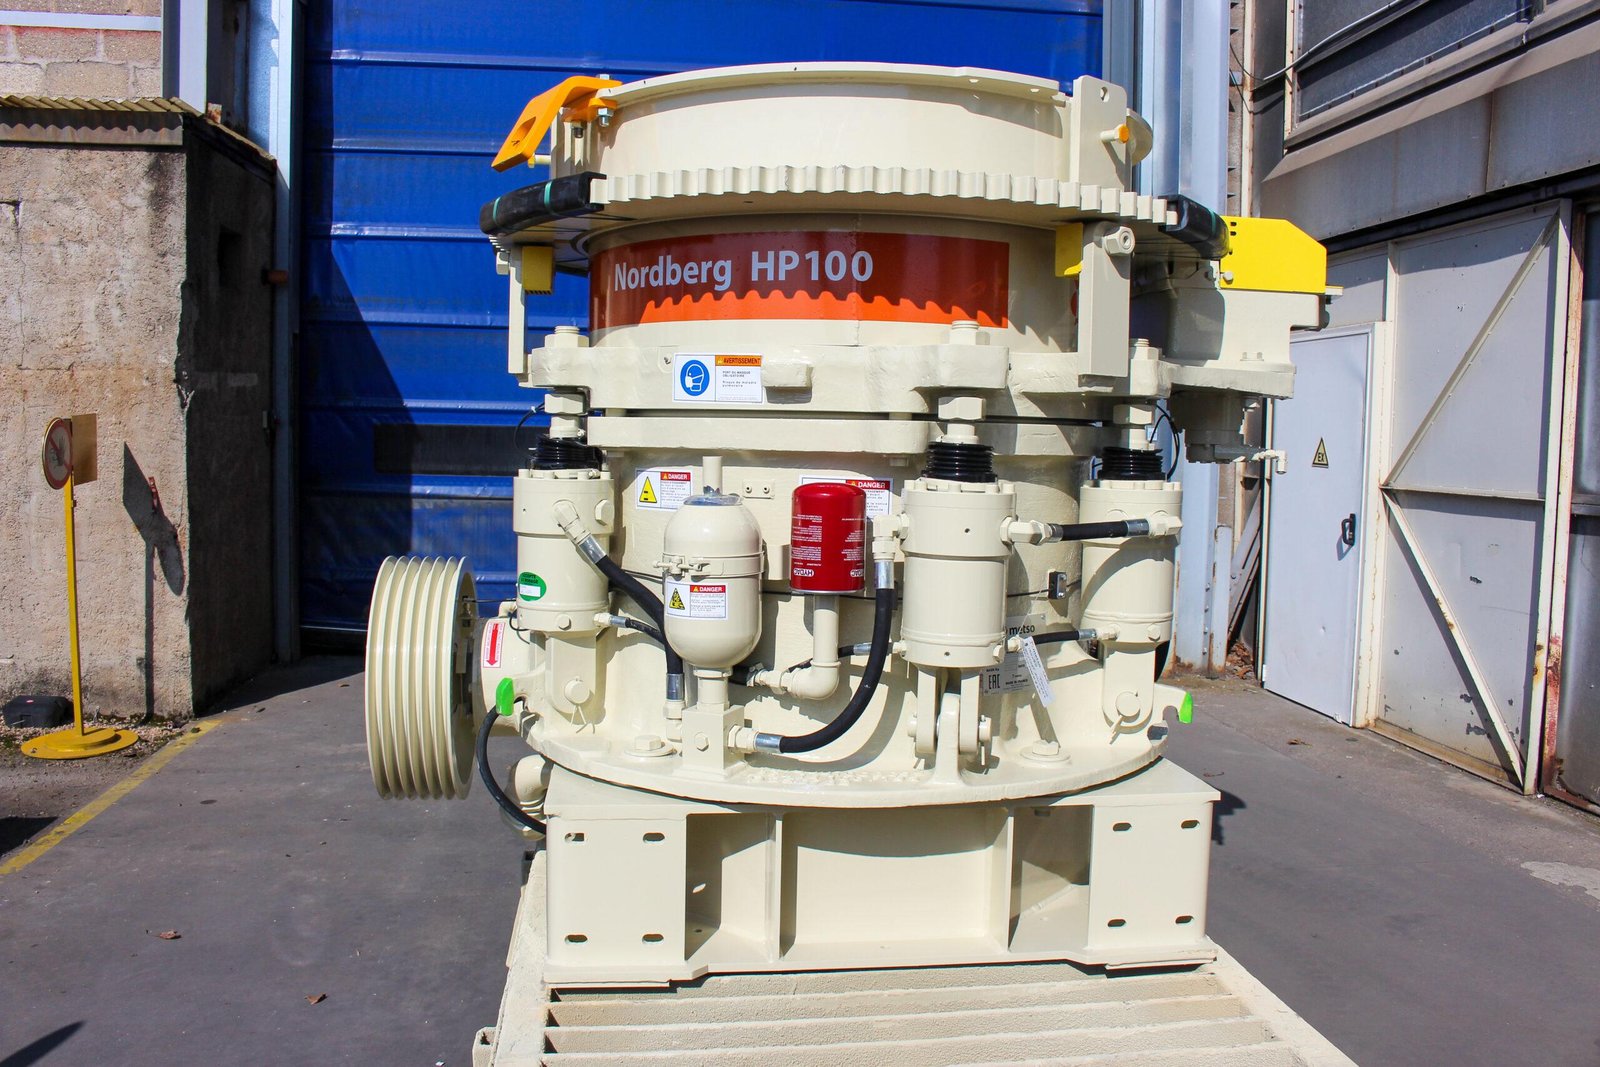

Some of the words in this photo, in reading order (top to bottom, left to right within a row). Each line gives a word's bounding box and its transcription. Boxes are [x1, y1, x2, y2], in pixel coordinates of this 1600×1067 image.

[614, 255, 732, 291] Nordberg
[751, 250, 874, 282] HP100
[857, 481, 885, 489] DANGER
[794, 568, 813, 576] HYDAC
[1009, 624, 1035, 635] metso
[988, 674, 1000, 689] EAC
